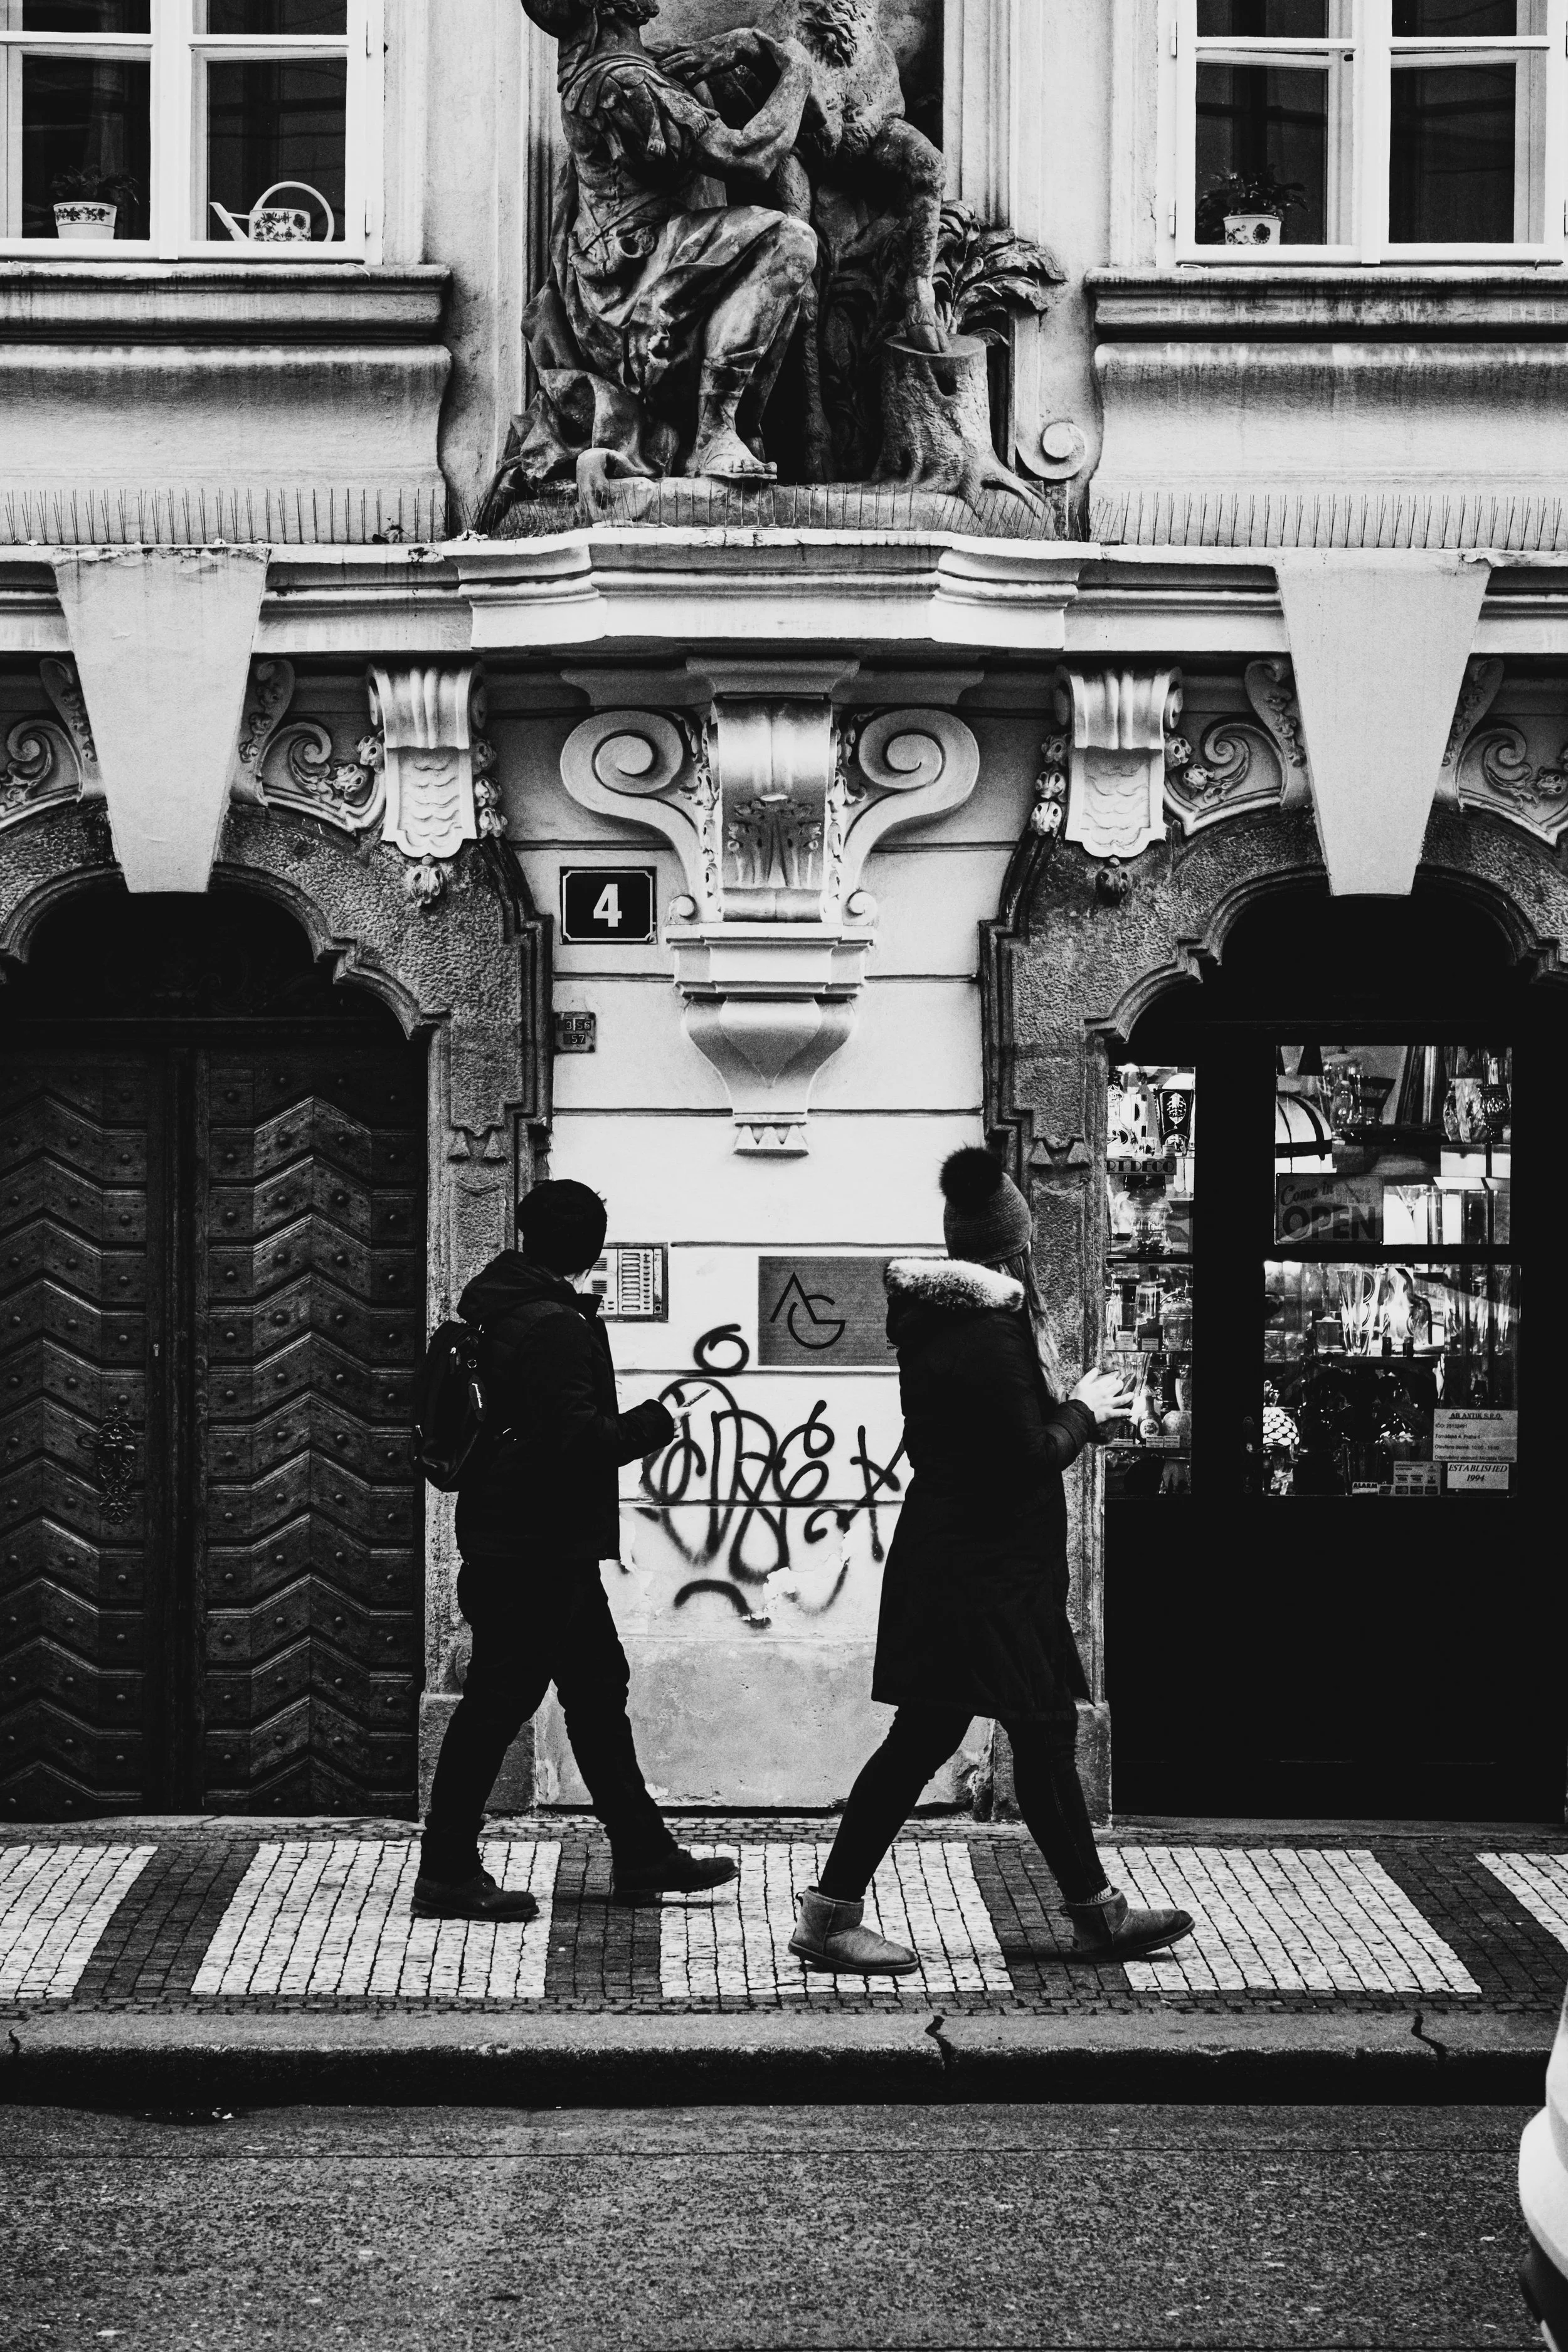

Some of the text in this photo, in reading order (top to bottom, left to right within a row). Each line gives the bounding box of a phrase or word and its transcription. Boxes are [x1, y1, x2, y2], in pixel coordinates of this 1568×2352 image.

[593, 884, 622, 927] 4
[571, 1034, 585, 1044] 57
[1105, 1160, 1175, 1172] RT DECO
[1280, 1185, 1318, 1205] Come
[1322, 1180, 1333, 1195] in
[1283, 1205, 1376, 1239] OPEN
[1448, 1465, 1508, 1473] ESTABLISHED
